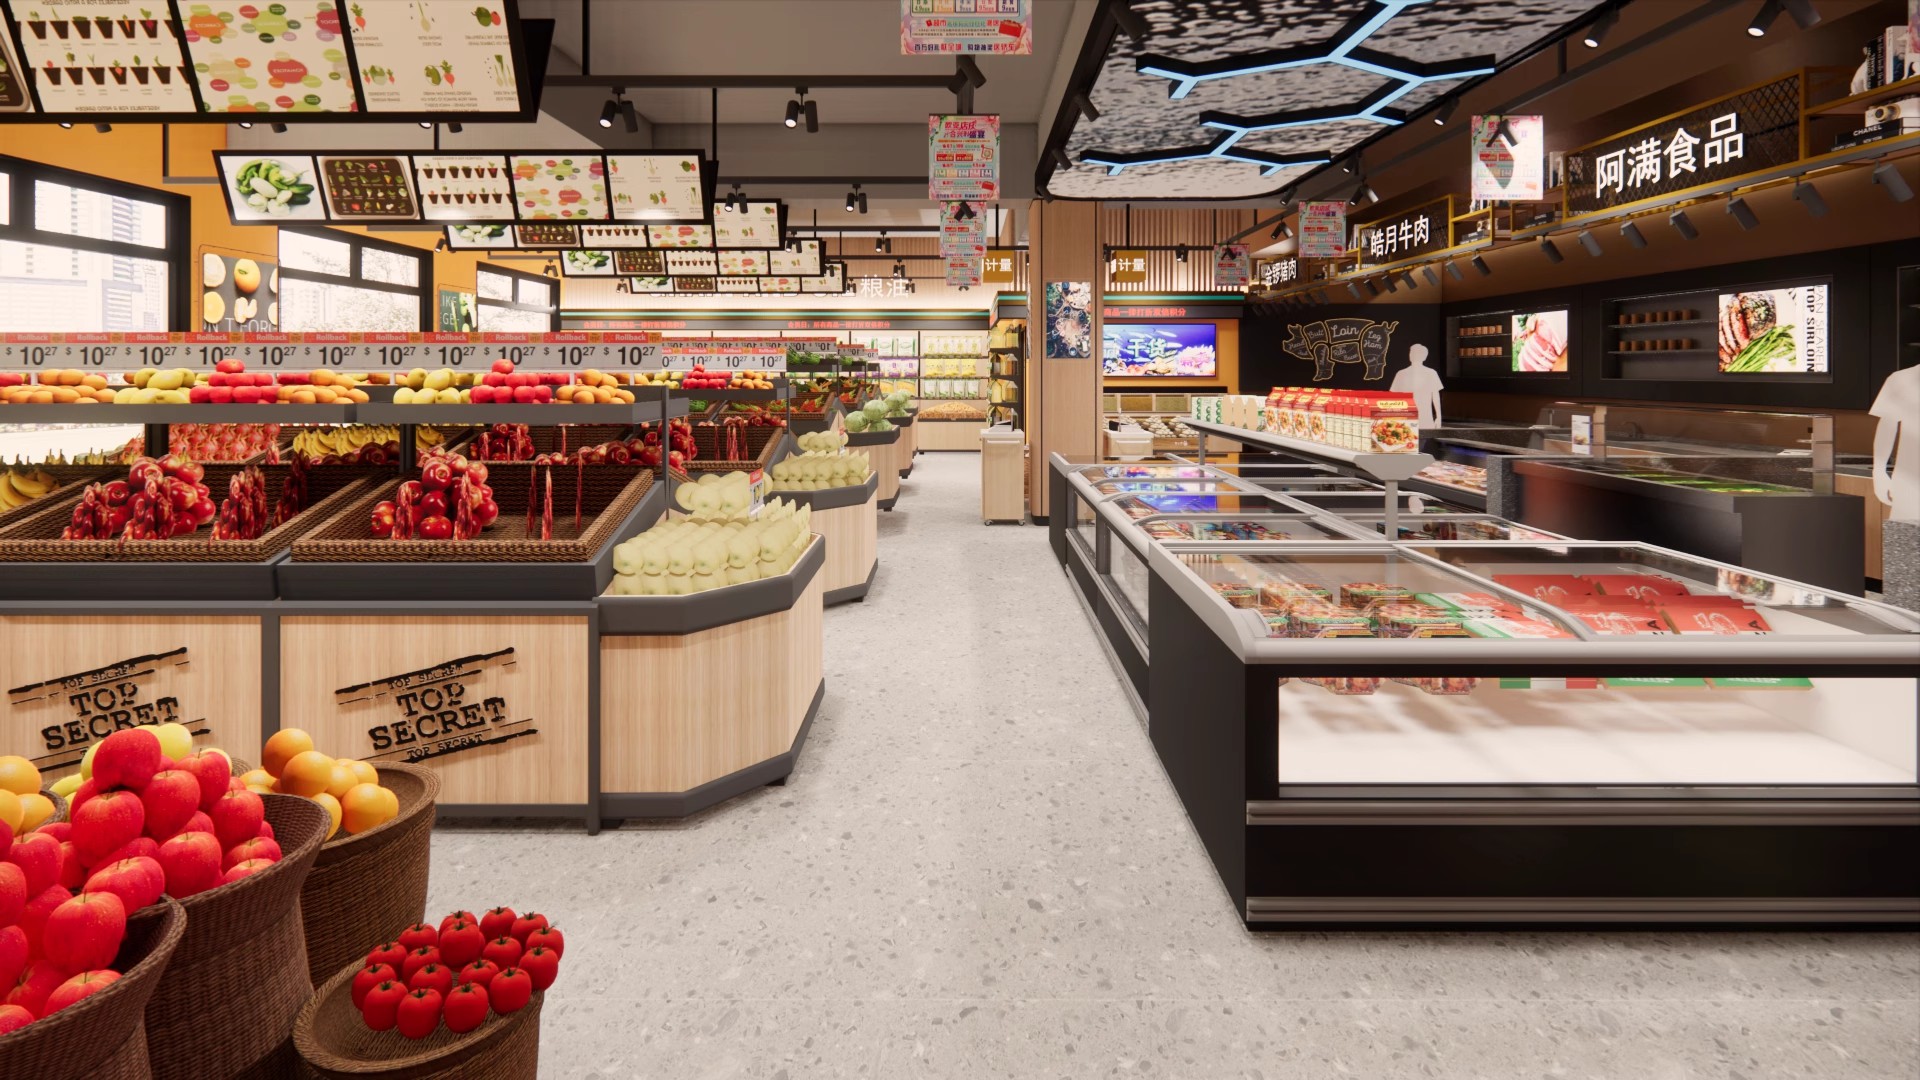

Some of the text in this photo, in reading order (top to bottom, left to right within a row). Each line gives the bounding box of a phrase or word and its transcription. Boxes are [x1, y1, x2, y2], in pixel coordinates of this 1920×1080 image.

[1853, 124, 1882, 137] CHANEL
[1596, 112, 1743, 199] 阿满食品
[1371, 215, 1429, 258] 皓月牛肉
[985, 258, 1012, 271] 计量
[1118, 258, 1145, 271] 计量
[860, 274, 909, 298] 粮油
[1331, 325, 1360, 338] Loin
[1807, 288, 1815, 372] TOP SIRLOIN
[69, 682, 138, 717] TOP
[396, 682, 465, 718] TOP
[41, 697, 179, 750] SECRET
[368, 697, 506, 750] SECRET
